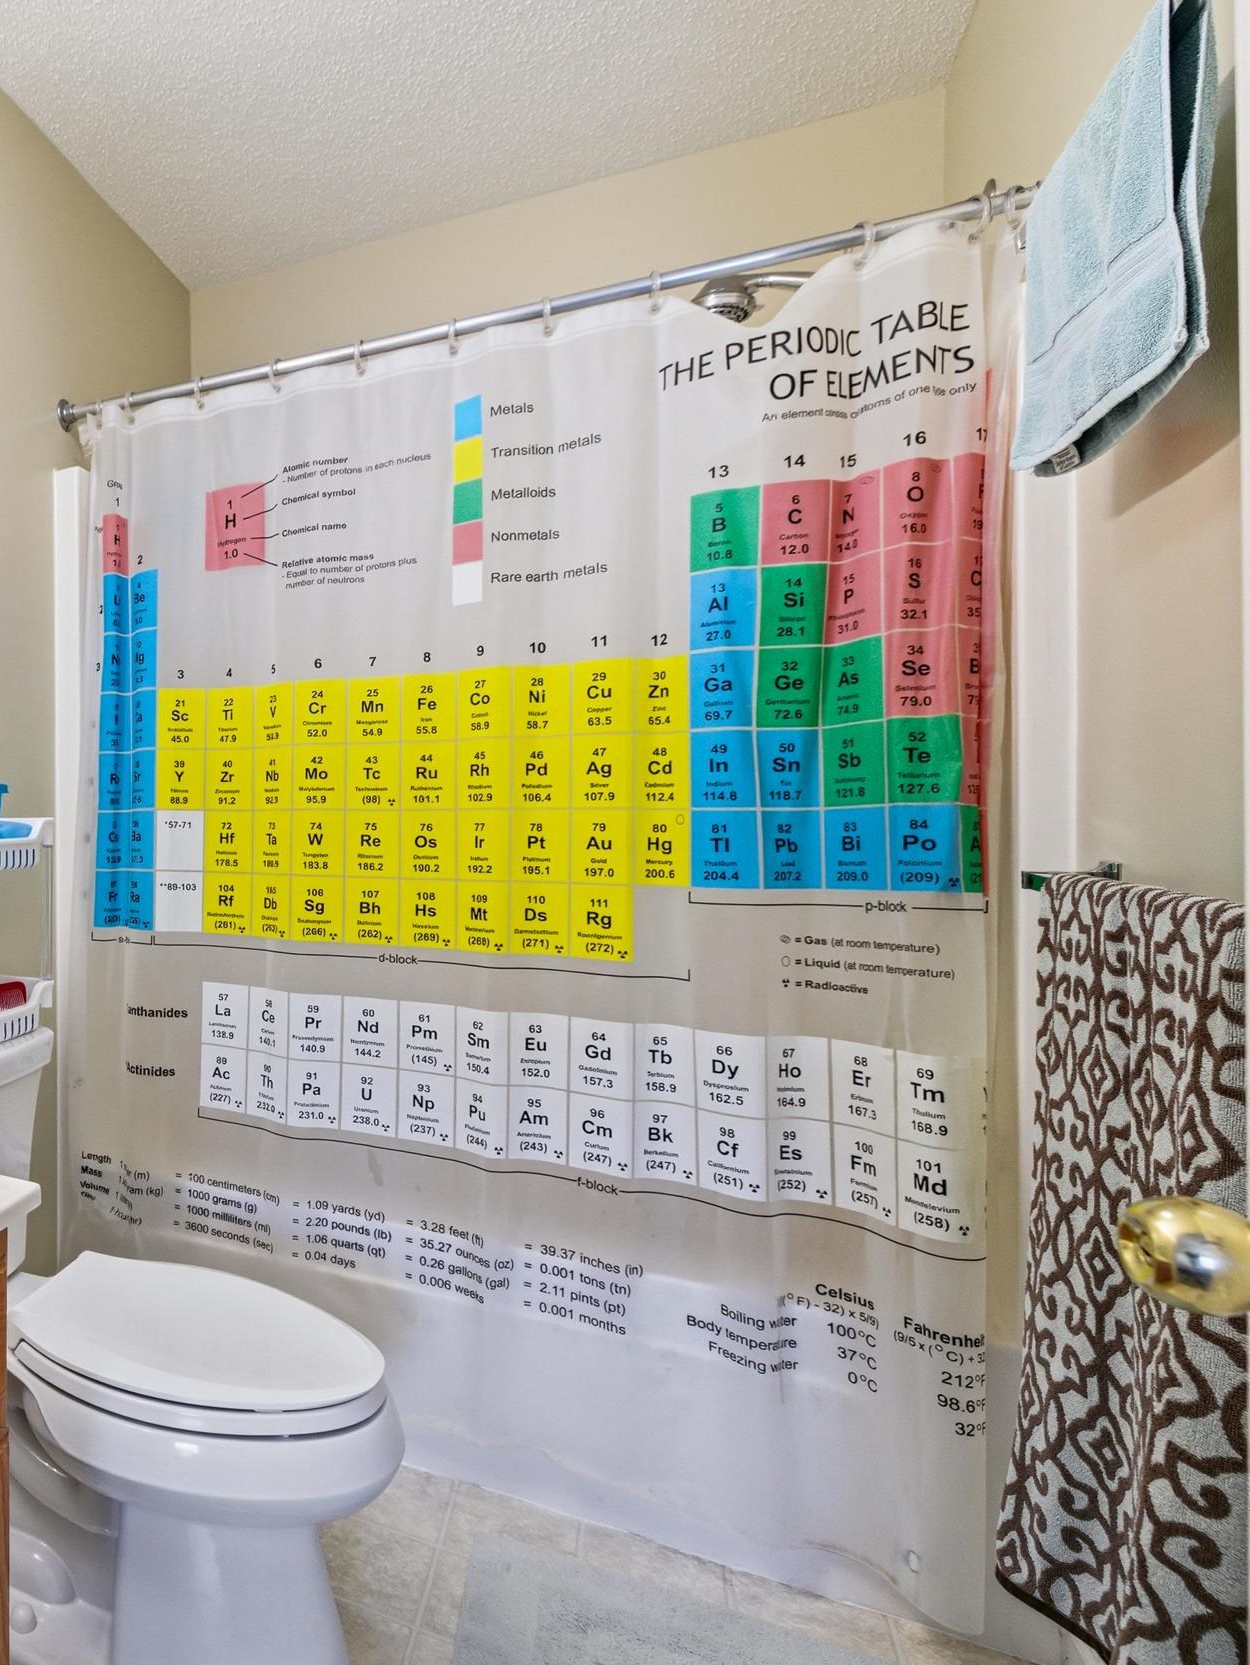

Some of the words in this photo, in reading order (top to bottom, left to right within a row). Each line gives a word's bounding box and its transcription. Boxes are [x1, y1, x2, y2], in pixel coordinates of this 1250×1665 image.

[659, 351, 714, 391] THE
[726, 326, 862, 370] PERIODIC
[870, 301, 969, 344] TABLE
[770, 370, 818, 400] OF
[827, 345, 974, 400] ELEMENTS
[490, 402, 534, 417] Metals
[491, 445, 553, 458] Transition
[558, 433, 601, 453] metals
[903, 431, 927, 446] 16
[282, 461, 310, 473] Atomic
[708, 465, 729, 478] 13
[784, 455, 806, 467] 14
[840, 454, 857, 467] 15
[282, 490, 320, 505] Chemical
[322, 488, 356, 498] symbol
[491, 487, 556, 501] Metalloids
[226, 514, 236, 529] H
[491, 529, 560, 543] Nonmetals
[224, 549, 238, 559] 1.0
[282, 556, 314, 568] Relative
[316, 554, 347, 564] atomic
[350, 553, 374, 561] mass
[491, 571, 522, 584] Rare
[526, 570, 558, 583] earth
[563, 563, 608, 579] metals
[529, 642, 546, 653] 10
[651, 634, 667, 646] 12
[709, 597, 728, 612] Al
[784, 593, 804, 608] Si
[902, 661, 930, 676] Se
[309, 702, 326, 714] Cr
[361, 701, 383, 712] Mn
[418, 699, 437, 710] Fe
[587, 686, 611, 699] Cu
[648, 685, 668, 699] Zn
[904, 748, 932, 764] Te
[305, 768, 328, 780] Mo
[526, 763, 547, 776] Pd
[587, 762, 611, 777] Ag
[415, 836, 437, 848] Os
[528, 836, 546, 849] Pt
[587, 837, 612, 850] Au
[648, 838, 672, 854] Hg
[903, 835, 936, 851] Po
[704, 872, 739, 881] 204.4
[865, 901, 906, 913] p-block
[587, 912, 612, 928] Rg
[804, 936, 827, 946] Gas
[379, 953, 418, 965] d-block
[805, 958, 840, 969] Liquid
[805, 980, 868, 994] Radioactive
[358, 1021, 379, 1033] Nd
[525, 1038, 546, 1051] Eu
[585, 1045, 612, 1060] Gd
[712, 1059, 738, 1079] Dy
[910, 1083, 945, 1103] Tm
[911, 1120, 948, 1137] 168.9
[81, 1152, 111, 1165] Length
[519, 1112, 548, 1126] Am
[582, 1121, 612, 1138] Cm
[914, 1174, 947, 1196] Md
[81, 1165, 102, 1178] Mass
[80, 1182, 109, 1195] Volume
[207, 1178, 261, 1198] centimeters
[578, 1177, 618, 1196] f-block
[188, 1189, 210, 1201] 1000
[212, 1195, 242, 1210] grams
[187, 1205, 209, 1217] 1000
[307, 1201, 328, 1211] 1.09
[331, 1203, 361, 1217] yards
[364, 1209, 385, 1223] (yd)
[306, 1218, 328, 1227] 2.20
[331, 1220, 369, 1236] pounds
[374, 1228, 392, 1242] (lb)
[420, 1220, 445, 1233] 3.28
[449, 1226, 469, 1241] feet
[913, 1213, 949, 1232] (258)
[185, 1221, 208, 1234] 3600
[211, 1227, 250, 1245] seconds
[306, 1235, 328, 1245] 1.06
[331, 1238, 364, 1252] quarts
[367, 1244, 386, 1259] (qt)
[420, 1238, 452, 1253] 35.27
[456, 1248, 490, 1268] ounces
[494, 1258, 514, 1270] (oz)
[305, 1251, 327, 1261] 0.04
[330, 1254, 356, 1269] days
[540, 1244, 576, 1260] 39.37
[580, 1252, 620, 1274] inches
[624, 1264, 643, 1278] (in)
[419, 1256, 445, 1269] 0.26
[448, 1263, 482, 1284] gallons
[486, 1277, 510, 1291] (gal)
[540, 1264, 574, 1280] 0.001
[580, 1272, 606, 1289] tons
[610, 1282, 631, 1298] (tn)
[419, 1274, 451, 1289] 0.006
[455, 1284, 484, 1304] weeks
[815, 1284, 874, 1311] Celsius
[540, 1283, 565, 1297] 2.11
[570, 1291, 600, 1308] pints
[604, 1300, 626, 1317] (pt)
[539, 1302, 573, 1319] 0.001
[579, 1312, 626, 1335] months
[687, 1315, 722, 1336] Body
[720, 1304, 765, 1331] Boiling
[708, 1341, 766, 1374] Freezing
